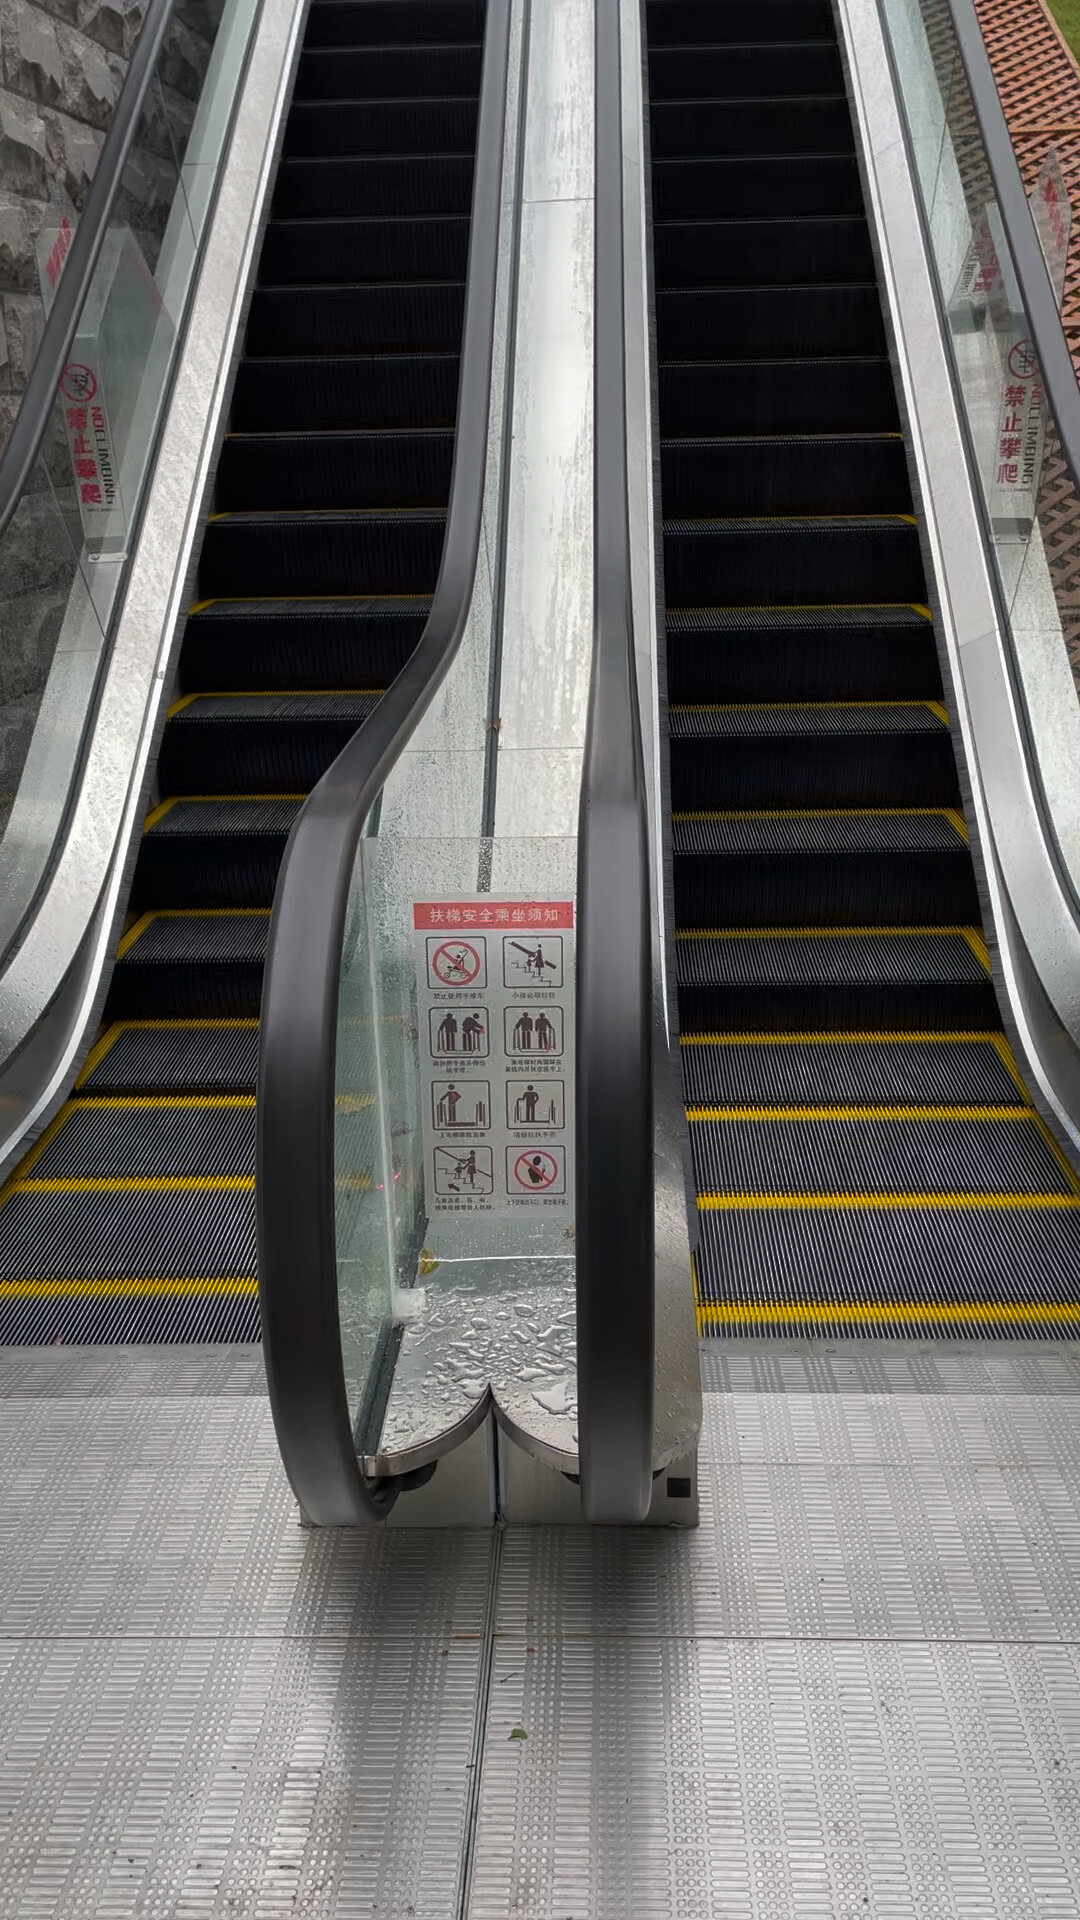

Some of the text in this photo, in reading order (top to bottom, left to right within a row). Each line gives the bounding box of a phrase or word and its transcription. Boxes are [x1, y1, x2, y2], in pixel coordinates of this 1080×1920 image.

[996, 384, 1026, 484] 禁止攀爬
[430, 908, 559, 923] 扶梯安全乘坐须知
